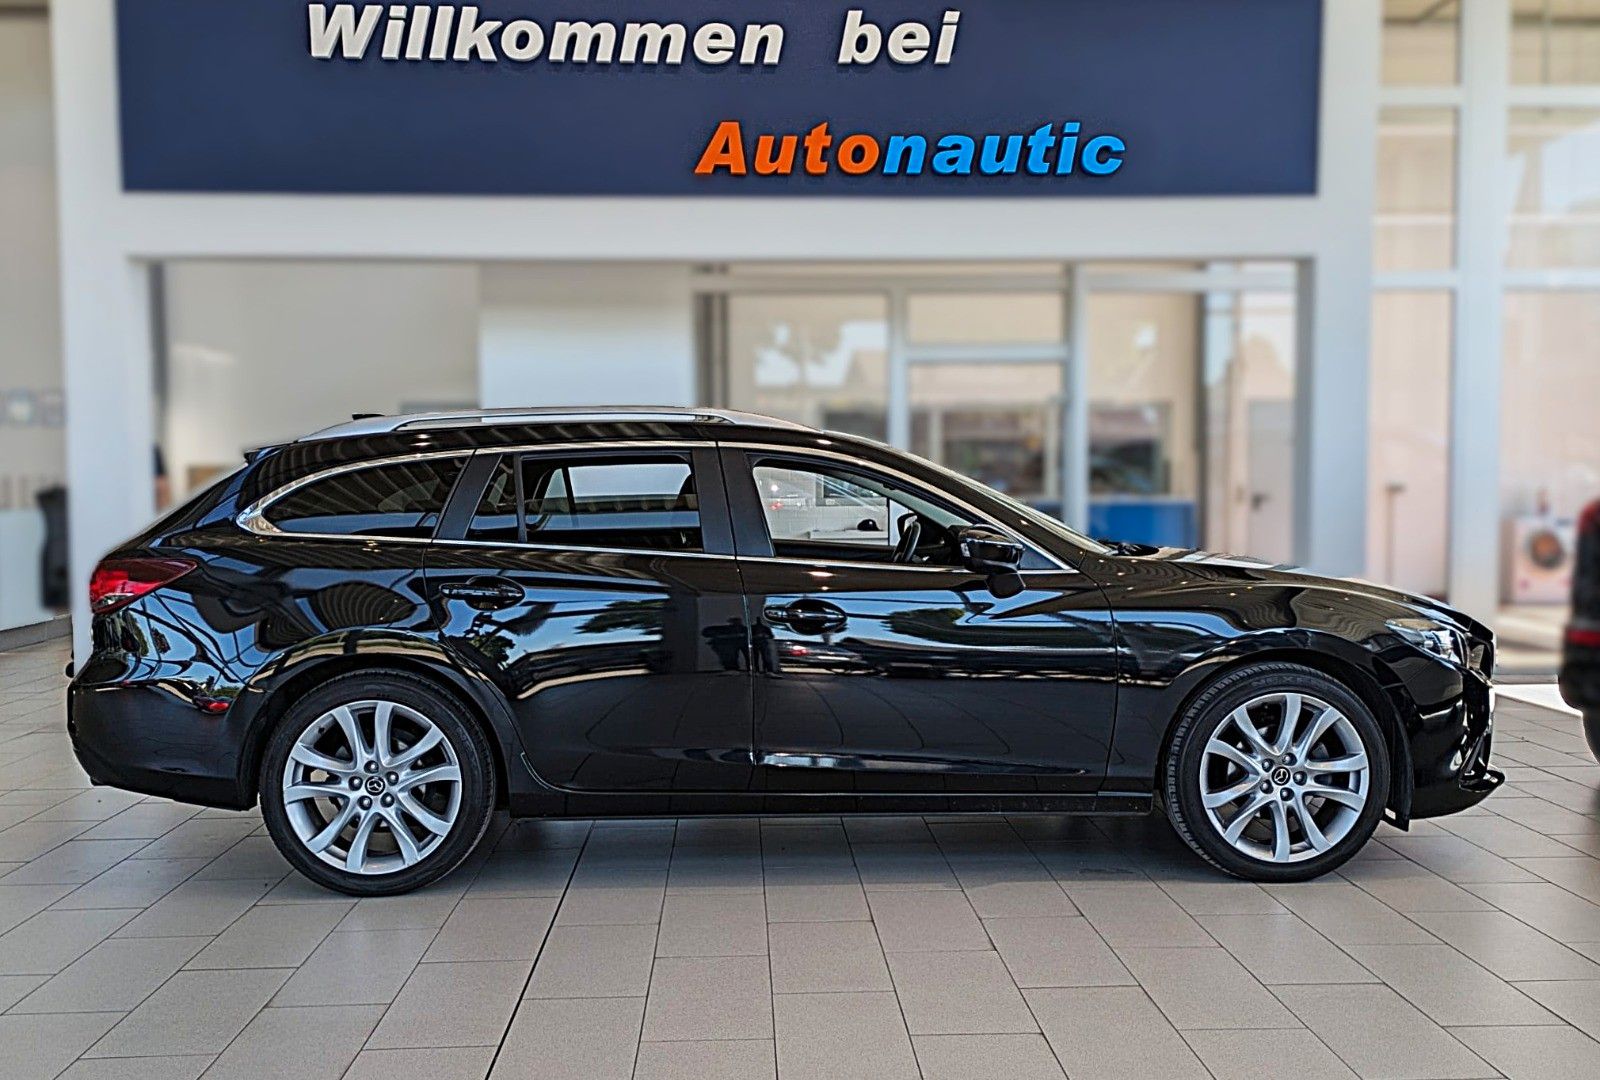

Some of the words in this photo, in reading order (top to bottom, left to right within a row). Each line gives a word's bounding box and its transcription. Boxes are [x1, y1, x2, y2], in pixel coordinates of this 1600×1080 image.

[308, 3, 784, 64] Willkommen
[838, 10, 960, 65] bei
[694, 121, 1126, 176] Autonautic
